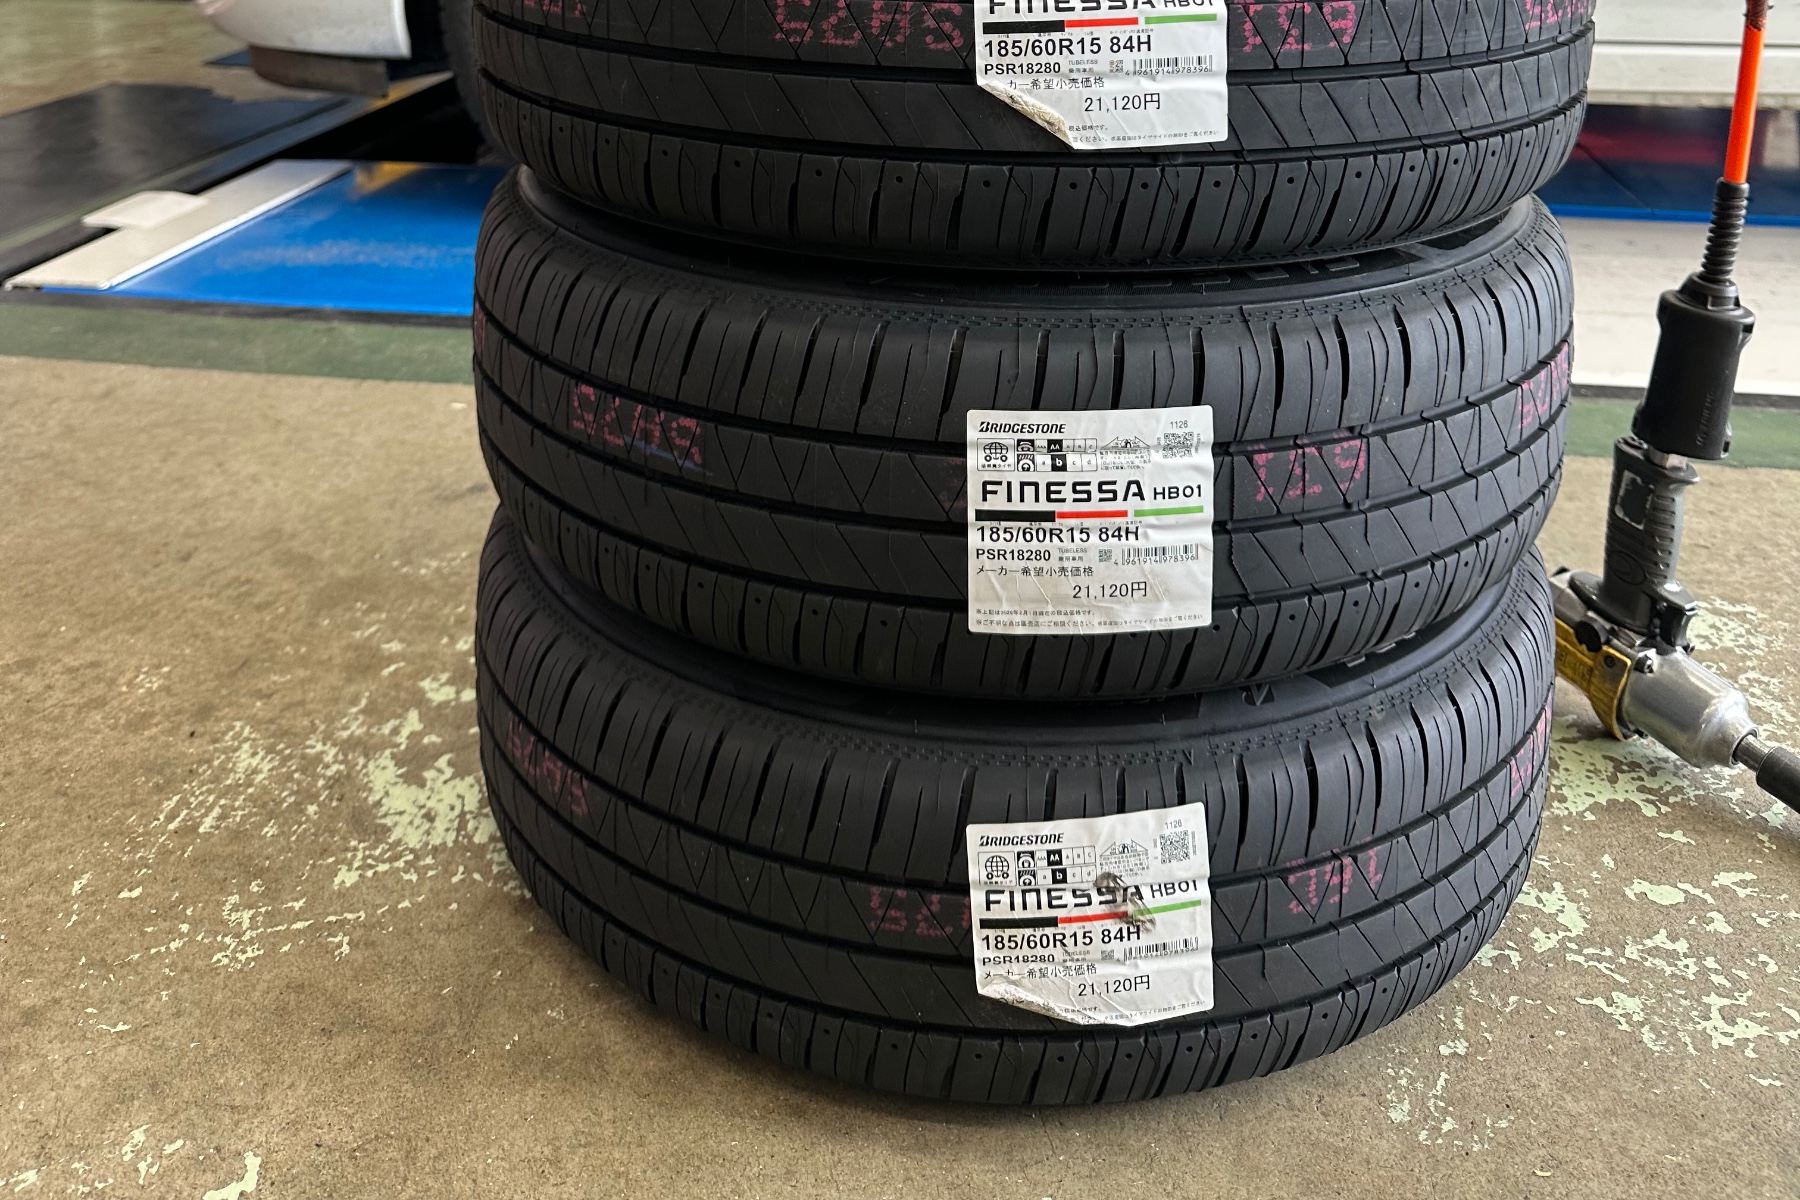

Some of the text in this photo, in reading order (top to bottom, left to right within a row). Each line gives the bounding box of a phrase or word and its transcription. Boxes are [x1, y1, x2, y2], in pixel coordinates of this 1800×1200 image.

[984, 37, 1101, 57] 185/60R15
[1109, 34, 1151, 53] 84H
[984, 62, 1061, 75] PSR18280
[1084, 92, 1160, 113] 21,120円
[978, 421, 1067, 434] BRIDGESTONE
[1170, 420, 1188, 429] 1126
[1056, 458, 1062, 466] b
[982, 479, 1201, 503] FINESSA HB01
[976, 525, 1139, 543] 185/60R15 84H
[976, 548, 1051, 561] PSR18280
[976, 565, 1094, 577] メーカー希望小売価格
[1072, 581, 1147, 599] 21,120円
[1165, 819, 1182, 829] 1126
[979, 832, 1064, 847] BRIDGESTONE
[1050, 853, 1060, 861] AA
[1056, 871, 1063, 880] b
[985, 885, 1144, 912] FINESSA
[981, 924, 1141, 951] 185/60R15 84H
[982, 954, 1055, 966] PSR18280
[1078, 974, 1150, 997] 21,120円
